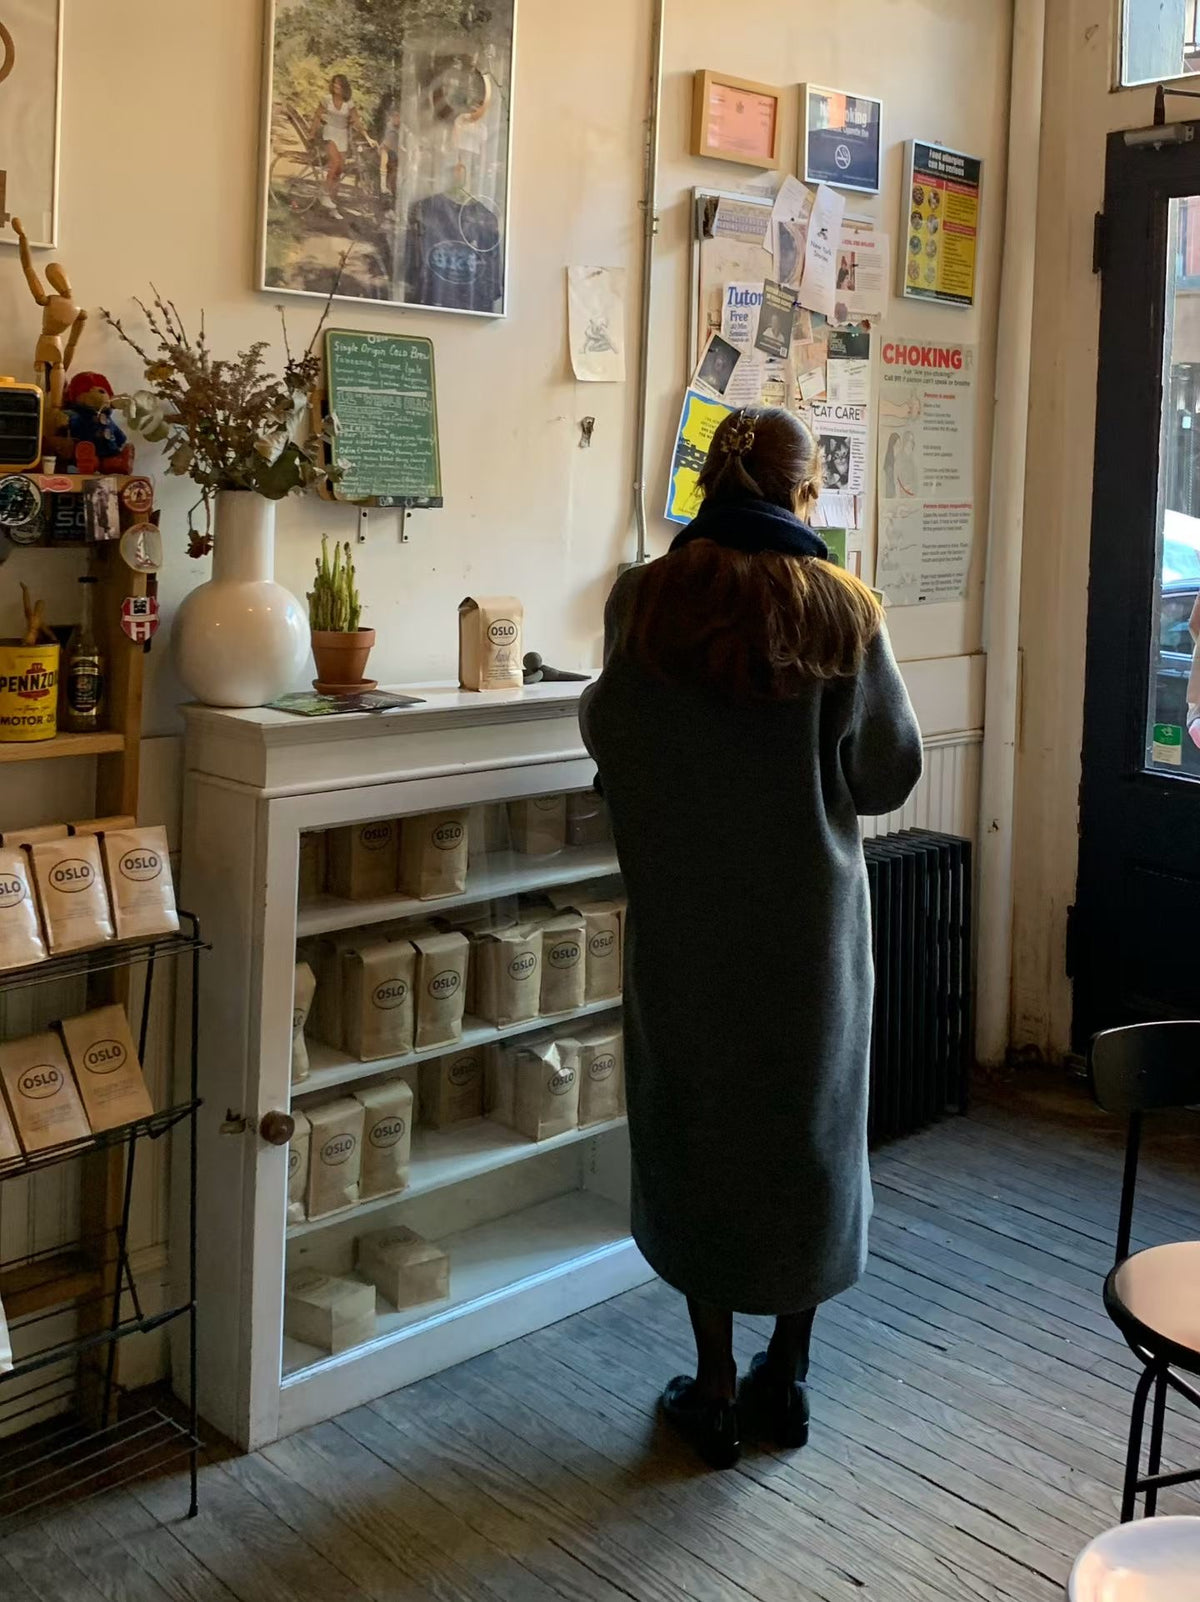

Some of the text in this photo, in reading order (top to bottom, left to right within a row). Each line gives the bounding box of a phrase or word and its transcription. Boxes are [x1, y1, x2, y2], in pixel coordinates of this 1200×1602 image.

[730, 310, 749, 322] Free
[334, 341, 359, 355] Single
[361, 343, 386, 357] Origin
[883, 343, 962, 370] CHOKING
[814, 406, 861, 421] CAT CARE
[491, 625, 515, 636] OSLO
[0, 715, 43, 726] MOTOR
[364, 827, 389, 840] OSLO
[436, 827, 461, 840] OSLO
[124, 856, 158, 870] OSLO
[54, 866, 90, 882] OSLO
[0, 880, 21, 894] SLO
[592, 936, 614, 949] OSLO
[552, 947, 578, 960] OSLO
[512, 957, 534, 971] OSLO
[432, 976, 457, 990] OSLO
[377, 985, 405, 1000] OSLO
[88, 1045, 122, 1064] OSLO
[591, 1059, 613, 1073] OSLO
[23, 1070, 59, 1089] OSLO
[552, 1072, 574, 1086] OSLO
[374, 1122, 401, 1139] OSLO
[325, 1139, 352, 1157] OSLO
